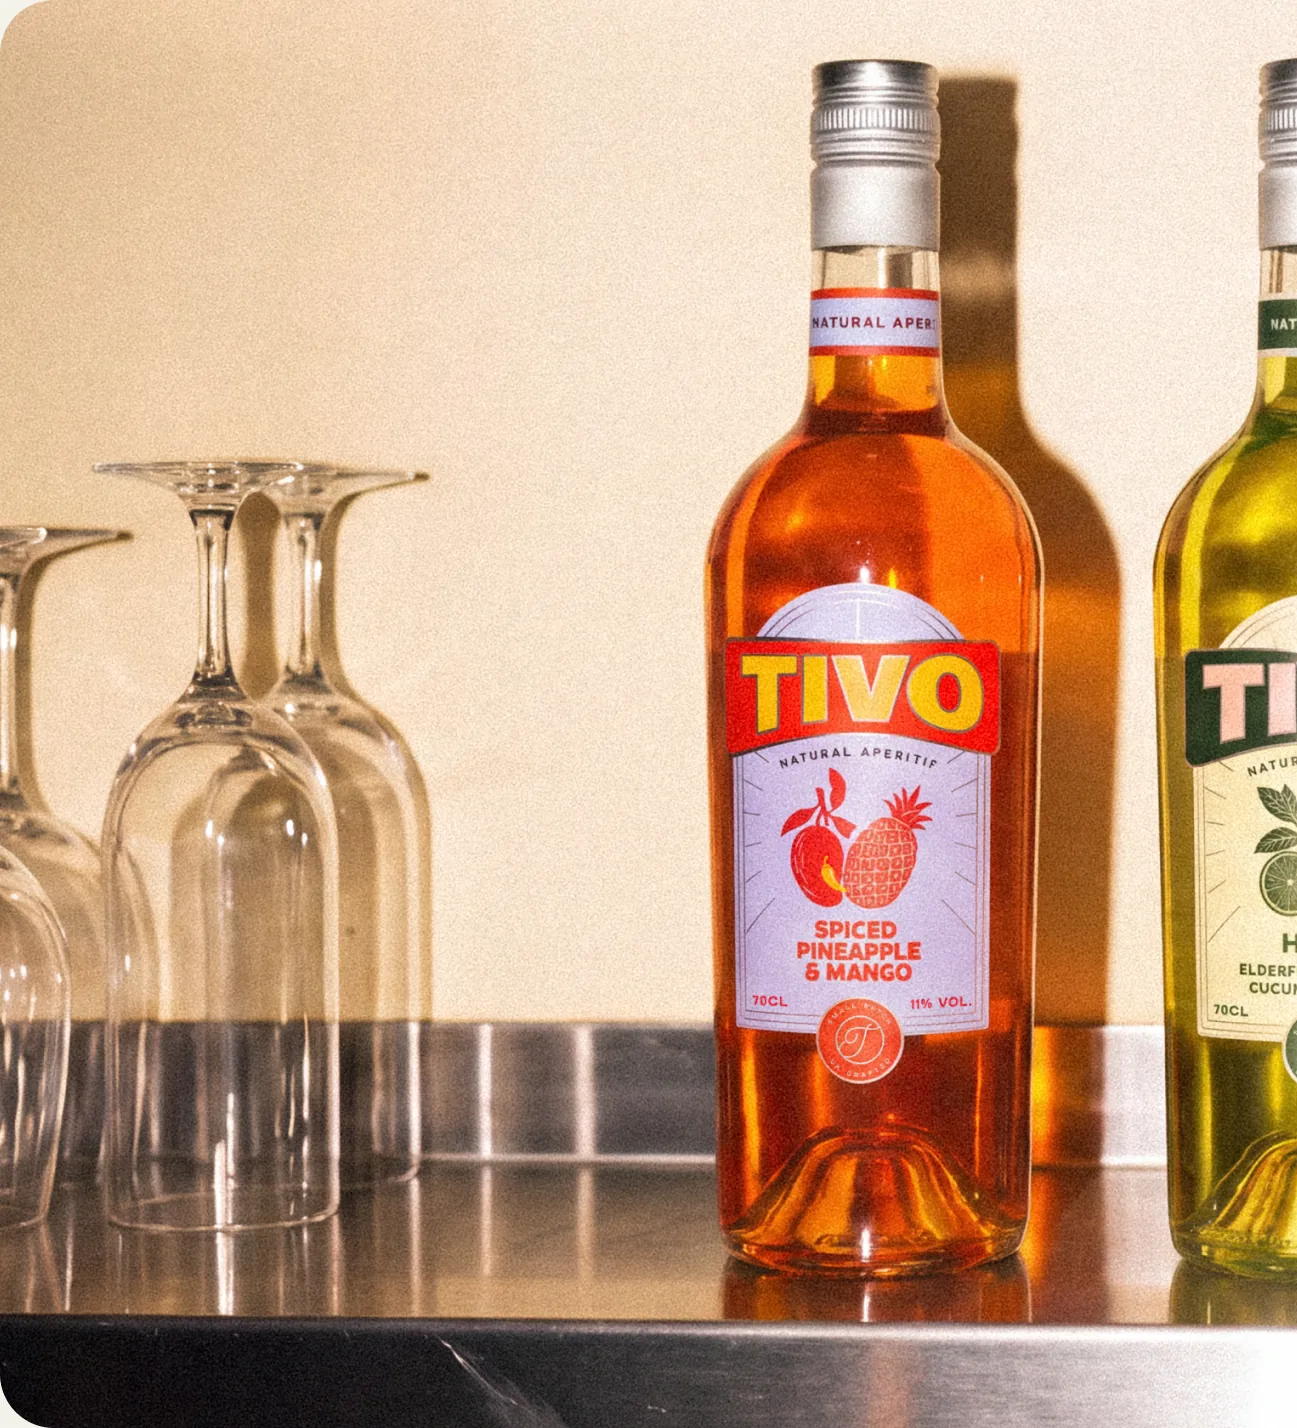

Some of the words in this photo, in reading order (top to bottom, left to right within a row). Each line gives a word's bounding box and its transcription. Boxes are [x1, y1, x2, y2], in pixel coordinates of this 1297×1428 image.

[812, 316, 886, 329] NATURAL
[740, 653, 985, 735] TIVO
[779, 747, 852, 769] NATURAL
[861, 747, 937, 769] APERITIF
[814, 920, 898, 939] SPICED
[796, 941, 922, 961] PINEAPPLE
[804, 963, 820, 982] &
[826, 963, 913, 982] MANGO
[752, 995, 788, 1007] 70CL
[910, 999, 933, 1010] 11%
[938, 996, 973, 1009] VOL.
[1213, 1004, 1249, 1017] 70CL
[846, 1058, 890, 1077] CRAFTED
